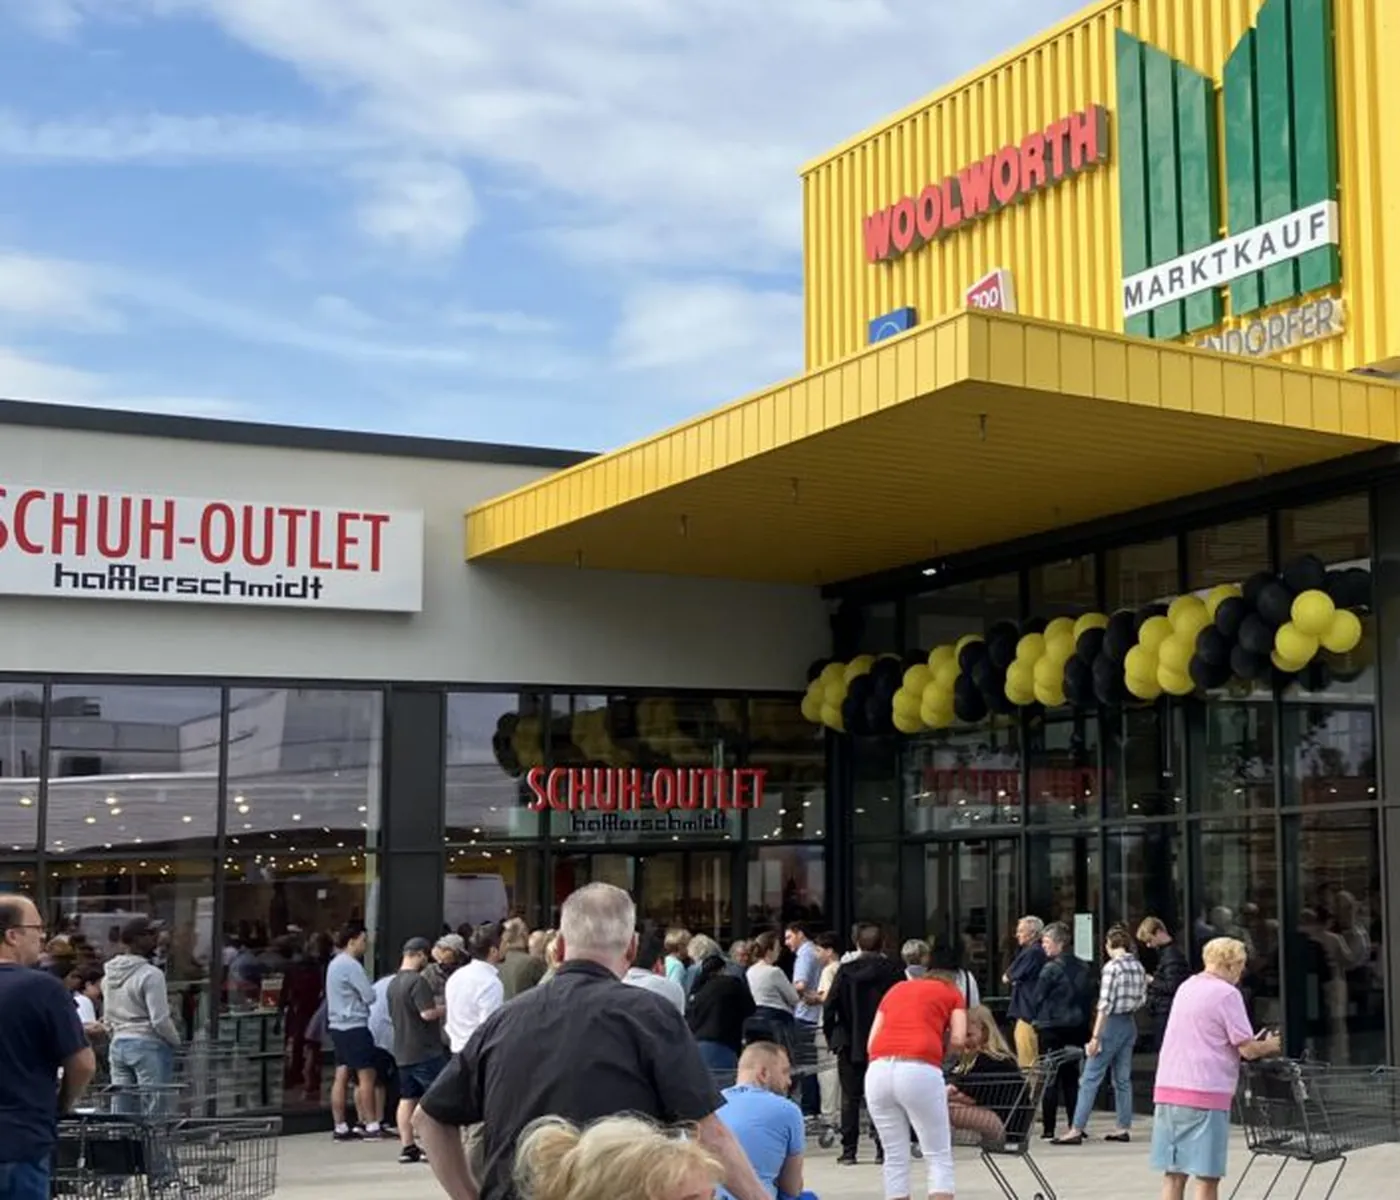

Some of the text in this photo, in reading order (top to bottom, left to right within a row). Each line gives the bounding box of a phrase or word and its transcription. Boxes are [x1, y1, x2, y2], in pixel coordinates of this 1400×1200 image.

[863, 104, 1101, 263] WOOLWORTH
[1124, 210, 1326, 308] MARKTKAUF
[527, 766, 767, 811] SCHUH-OUTLET
